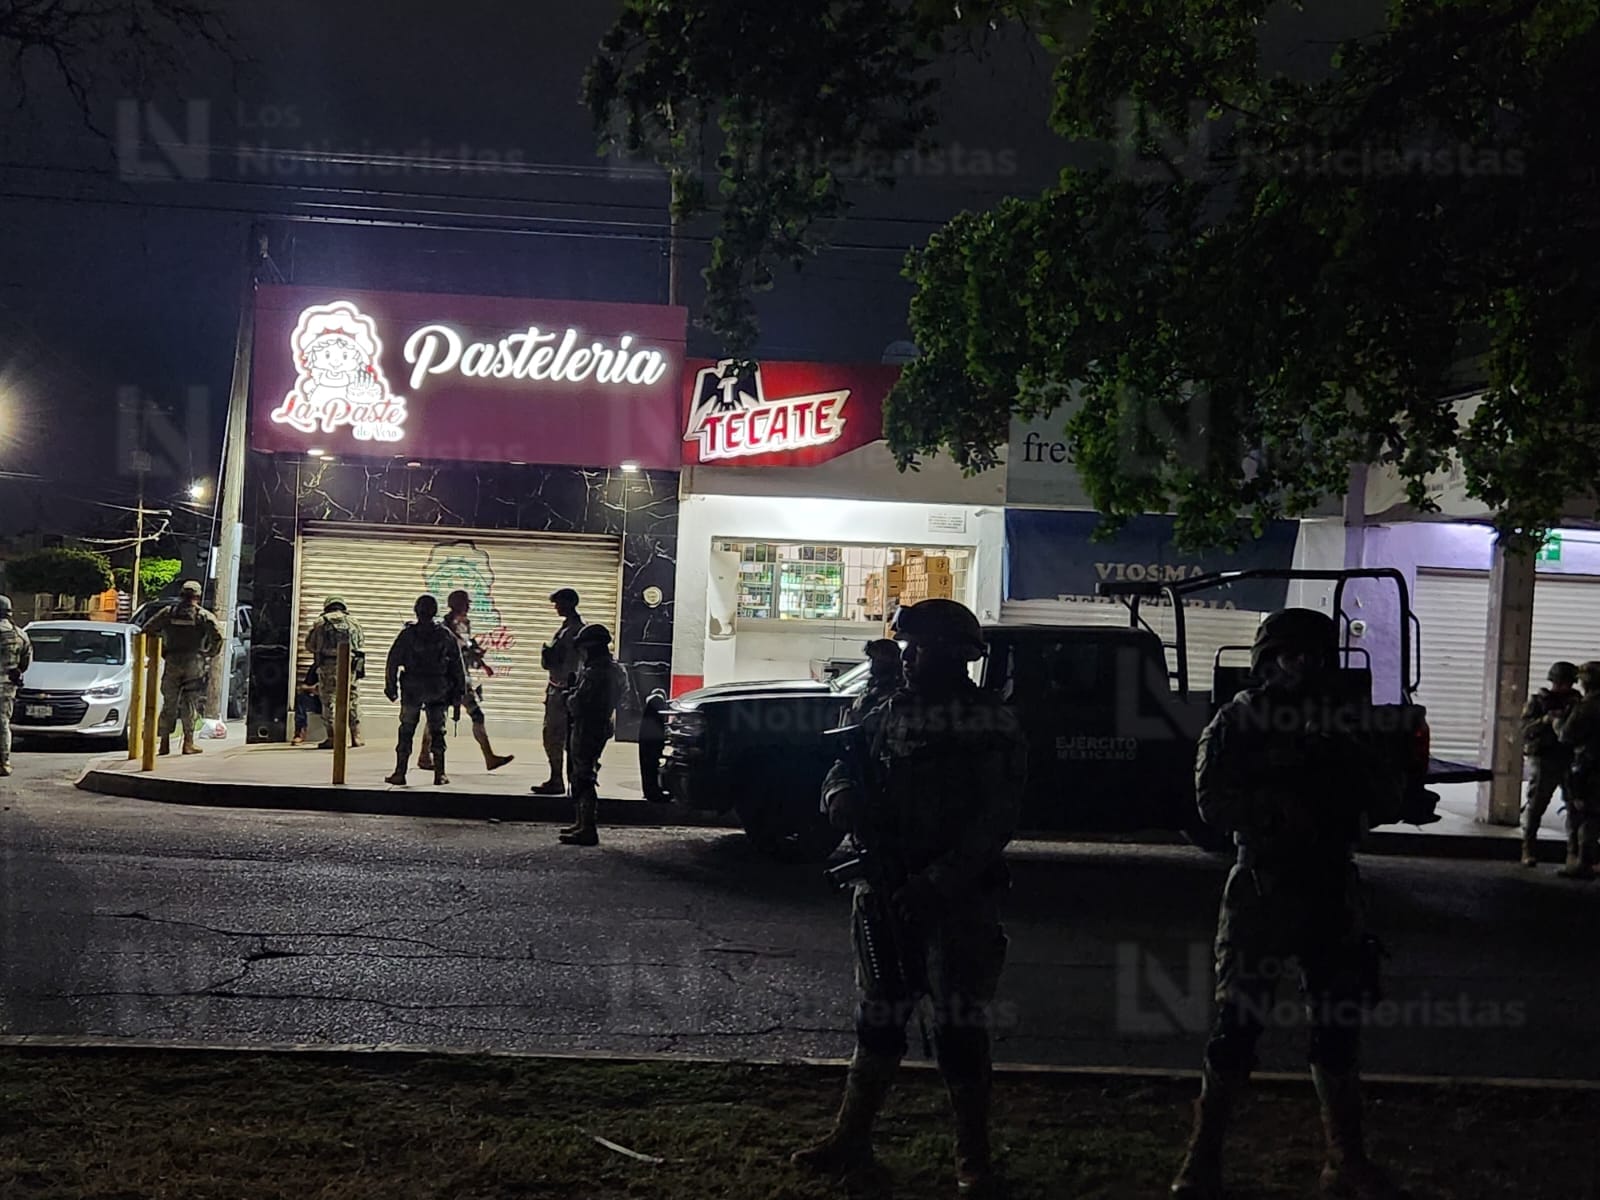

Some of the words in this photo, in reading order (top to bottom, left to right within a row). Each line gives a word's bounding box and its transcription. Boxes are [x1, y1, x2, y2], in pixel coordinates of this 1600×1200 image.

[274, 394, 315, 428] La
[321, 396, 403, 429] Paste
[698, 396, 840, 457] TECATE
[1094, 562, 1205, 582] VIOSMA
